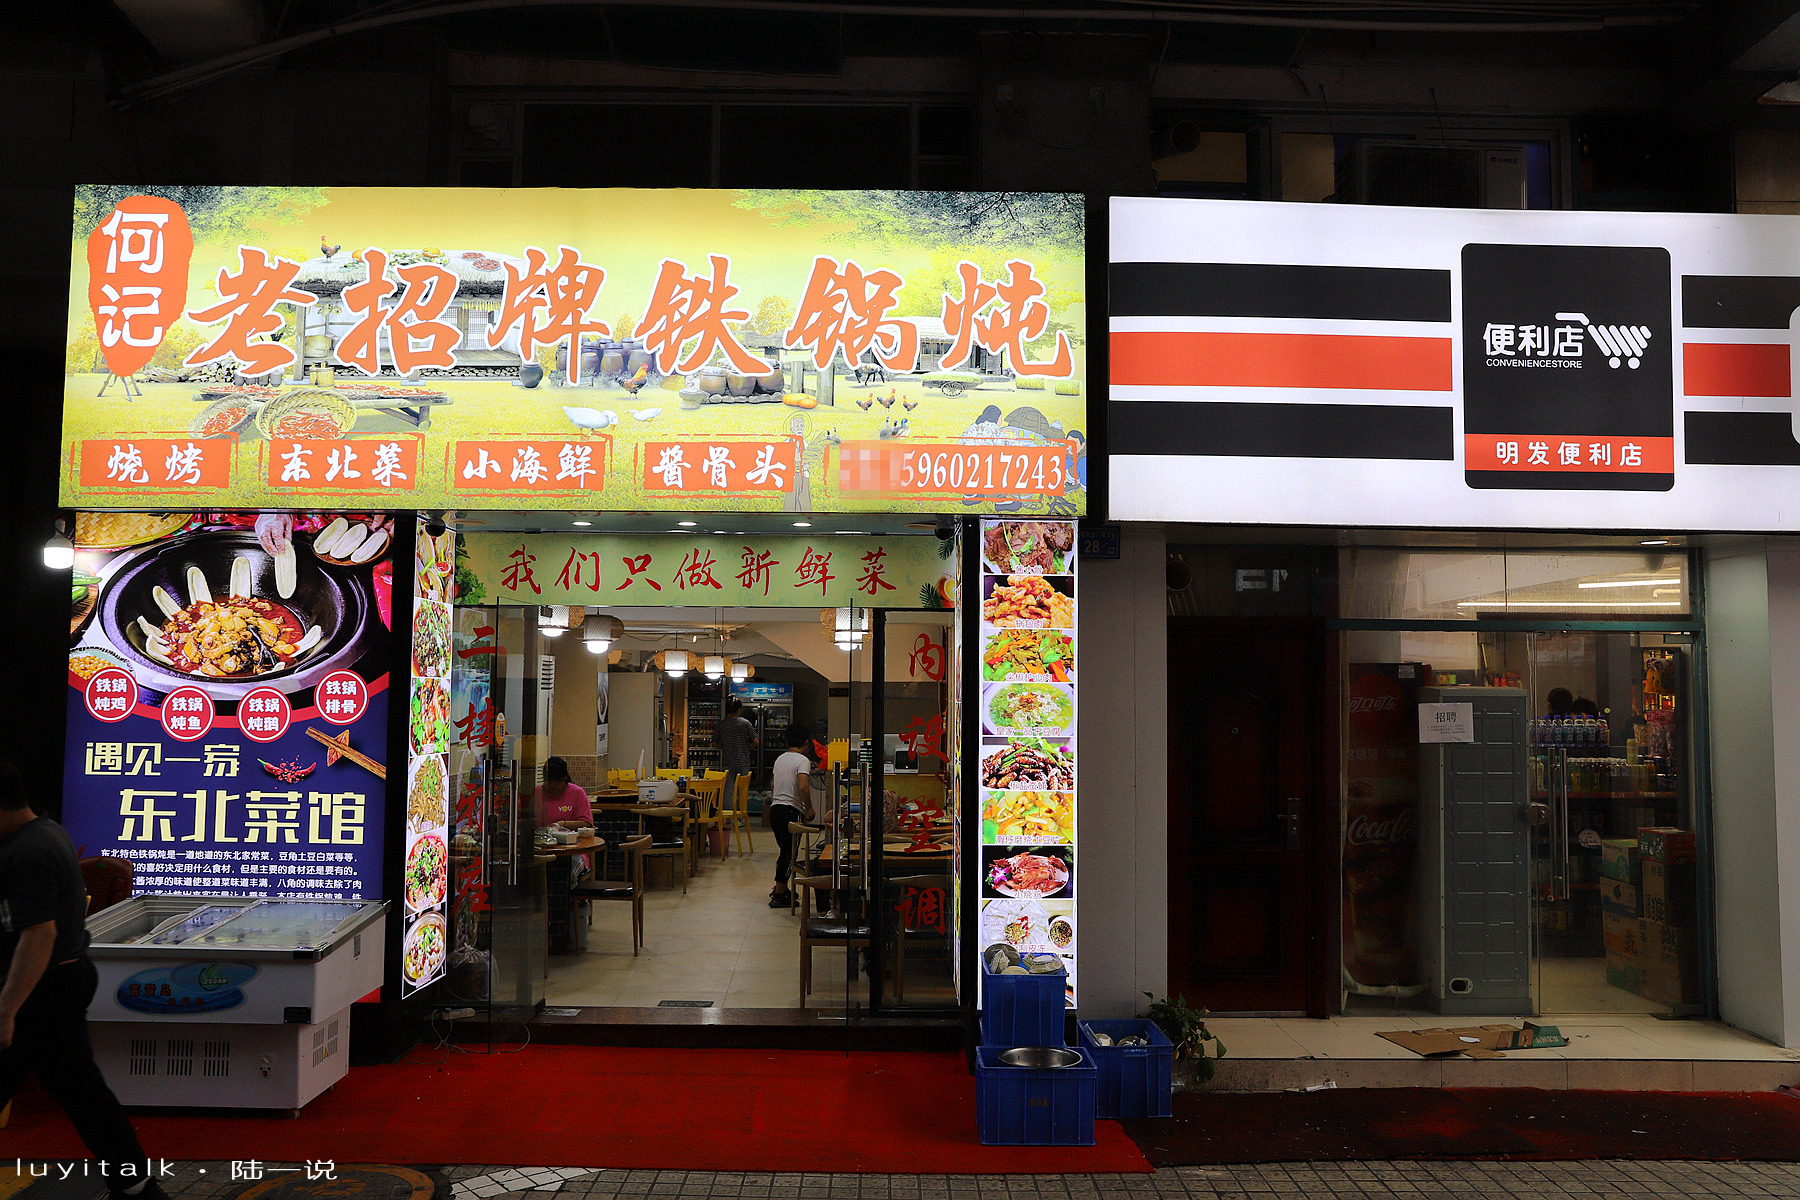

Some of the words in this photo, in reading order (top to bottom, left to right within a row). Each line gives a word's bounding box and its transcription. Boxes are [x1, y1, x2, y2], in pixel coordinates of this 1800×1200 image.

[99, 210, 168, 347] 何记
[183, 245, 1076, 387] 老招牌铁锅炖
[1483, 322, 1584, 357] 便利店
[1486, 358, 1583, 369] CONVENIENCESTORE
[1496, 441, 1642, 467] 明发便利店
[281, 442, 408, 487] 东北菜
[463, 443, 597, 488] 小海鲜
[1084, 539, 1100, 554] 28
[500, 544, 897, 596] 我们只做新鲜菜
[95, 678, 127, 693] 铁锅
[325, 680, 357, 696] 铁锅
[94, 696, 126, 711] 炖鸡
[171, 697, 203, 712] 铁锅
[247, 698, 280, 713] 铁锅
[325, 698, 357, 714] 排骨
[170, 715, 202, 730] 炖鱼
[247, 716, 279, 732] 炖鹅
[1435, 711, 1457, 723] 招聘
[84, 742, 240, 778] 遇见一家
[117, 788, 366, 845] 东北菜馆
